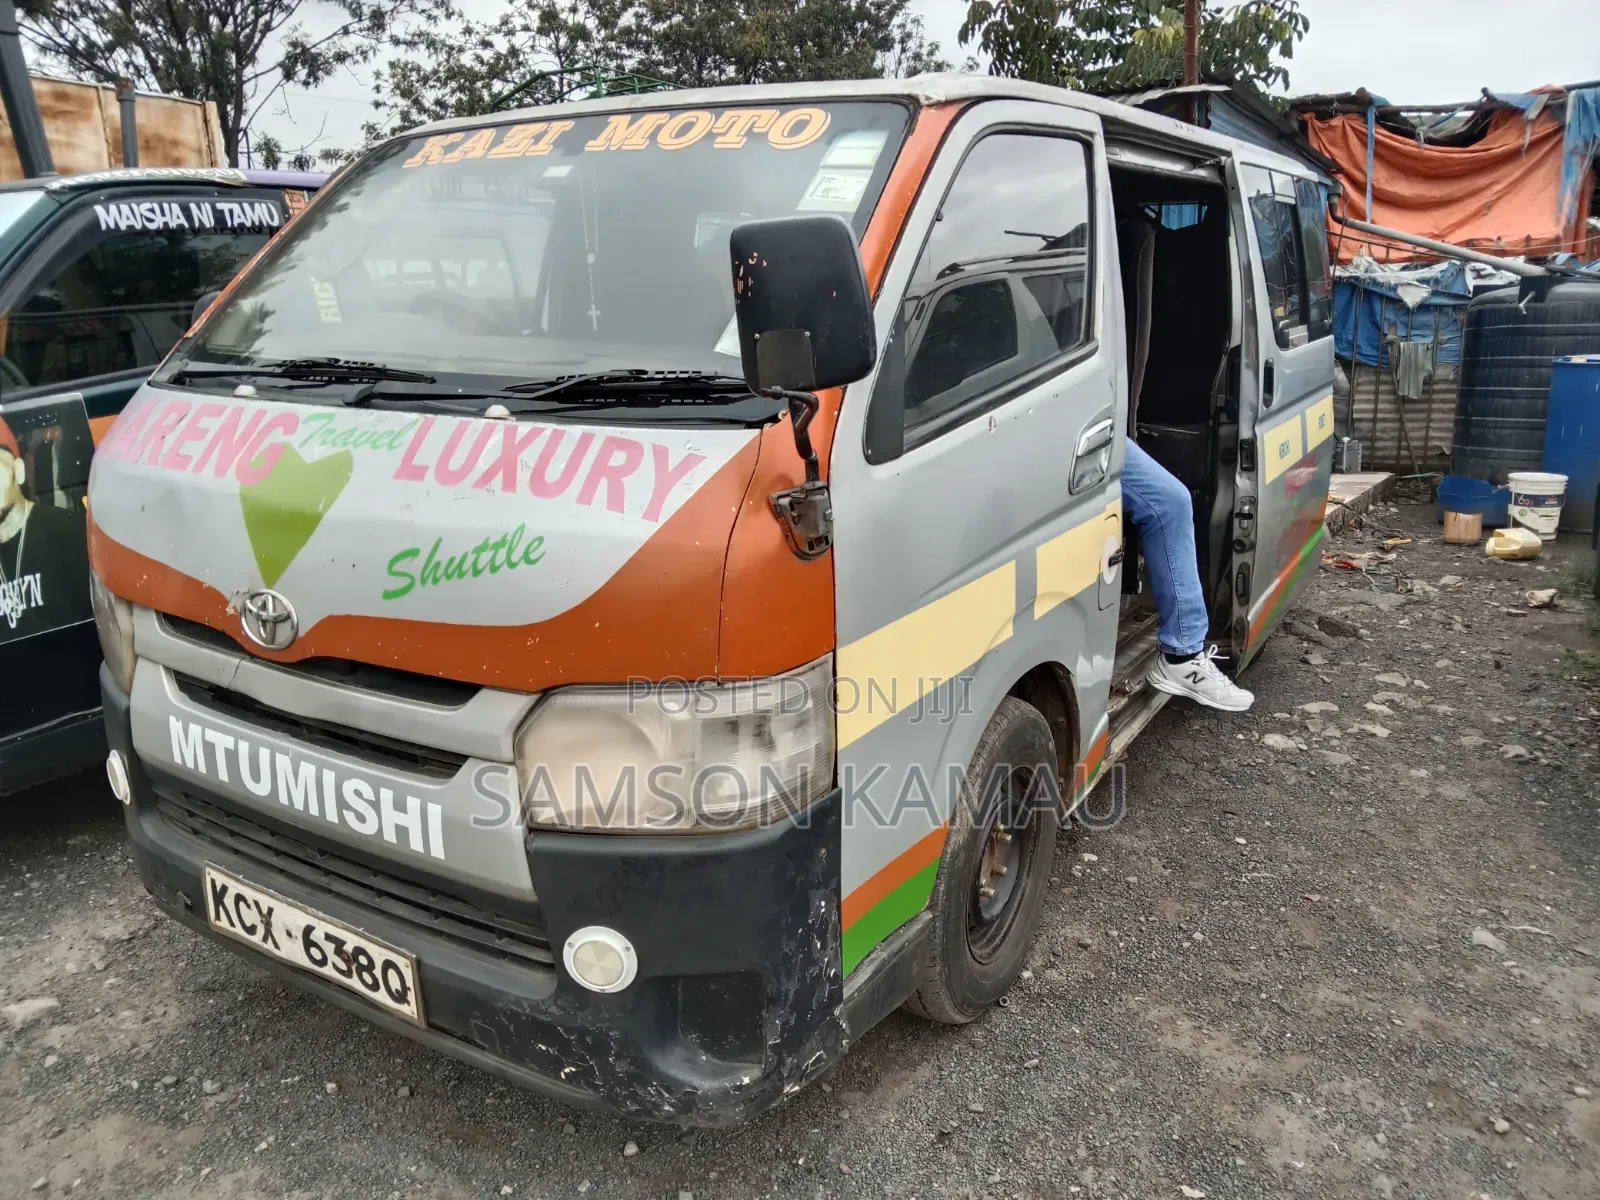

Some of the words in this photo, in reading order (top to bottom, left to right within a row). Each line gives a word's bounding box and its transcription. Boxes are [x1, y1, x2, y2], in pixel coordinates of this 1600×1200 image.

[403, 120, 575, 168] KAZI
[585, 107, 832, 150] MOTO
[93, 203, 190, 231] MAISHA
[189, 202, 215, 229] NI
[216, 203, 280, 228] TAMU
[300, 413, 408, 452] Travel
[393, 415, 707, 524] LUXURY
[381, 523, 546, 601] Shuttle
[168, 715, 446, 861] MTUMISHI
